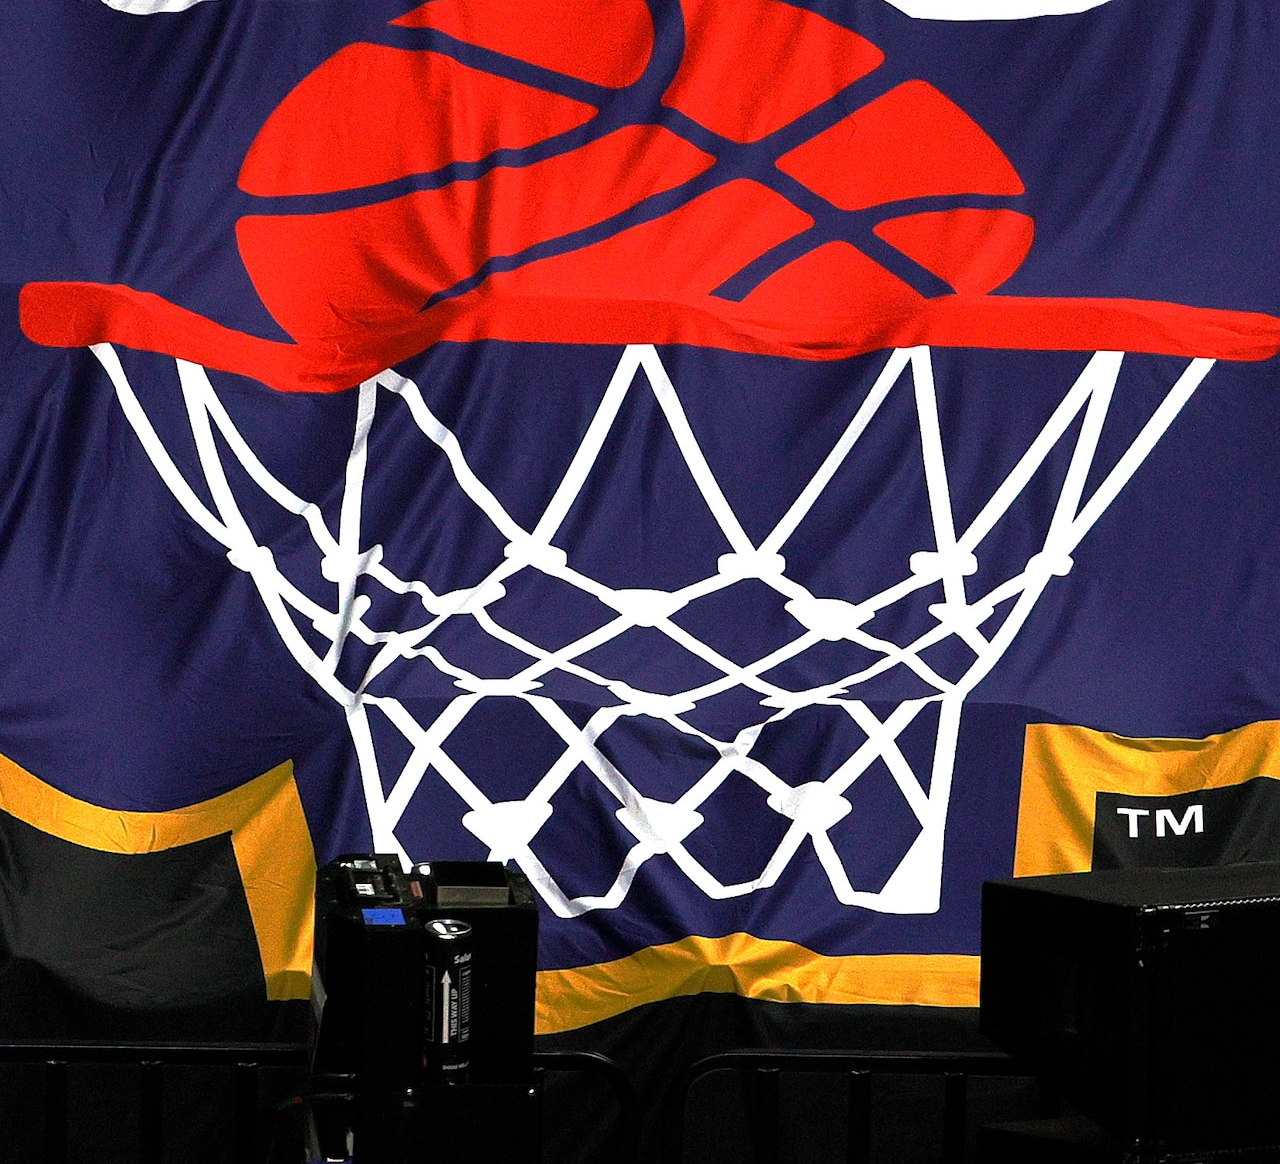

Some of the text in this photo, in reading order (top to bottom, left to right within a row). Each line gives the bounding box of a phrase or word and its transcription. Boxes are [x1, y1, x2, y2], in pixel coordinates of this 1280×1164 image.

[1117, 805, 1204, 838] TM
[450, 988, 458, 1037] THIS WAY UP
